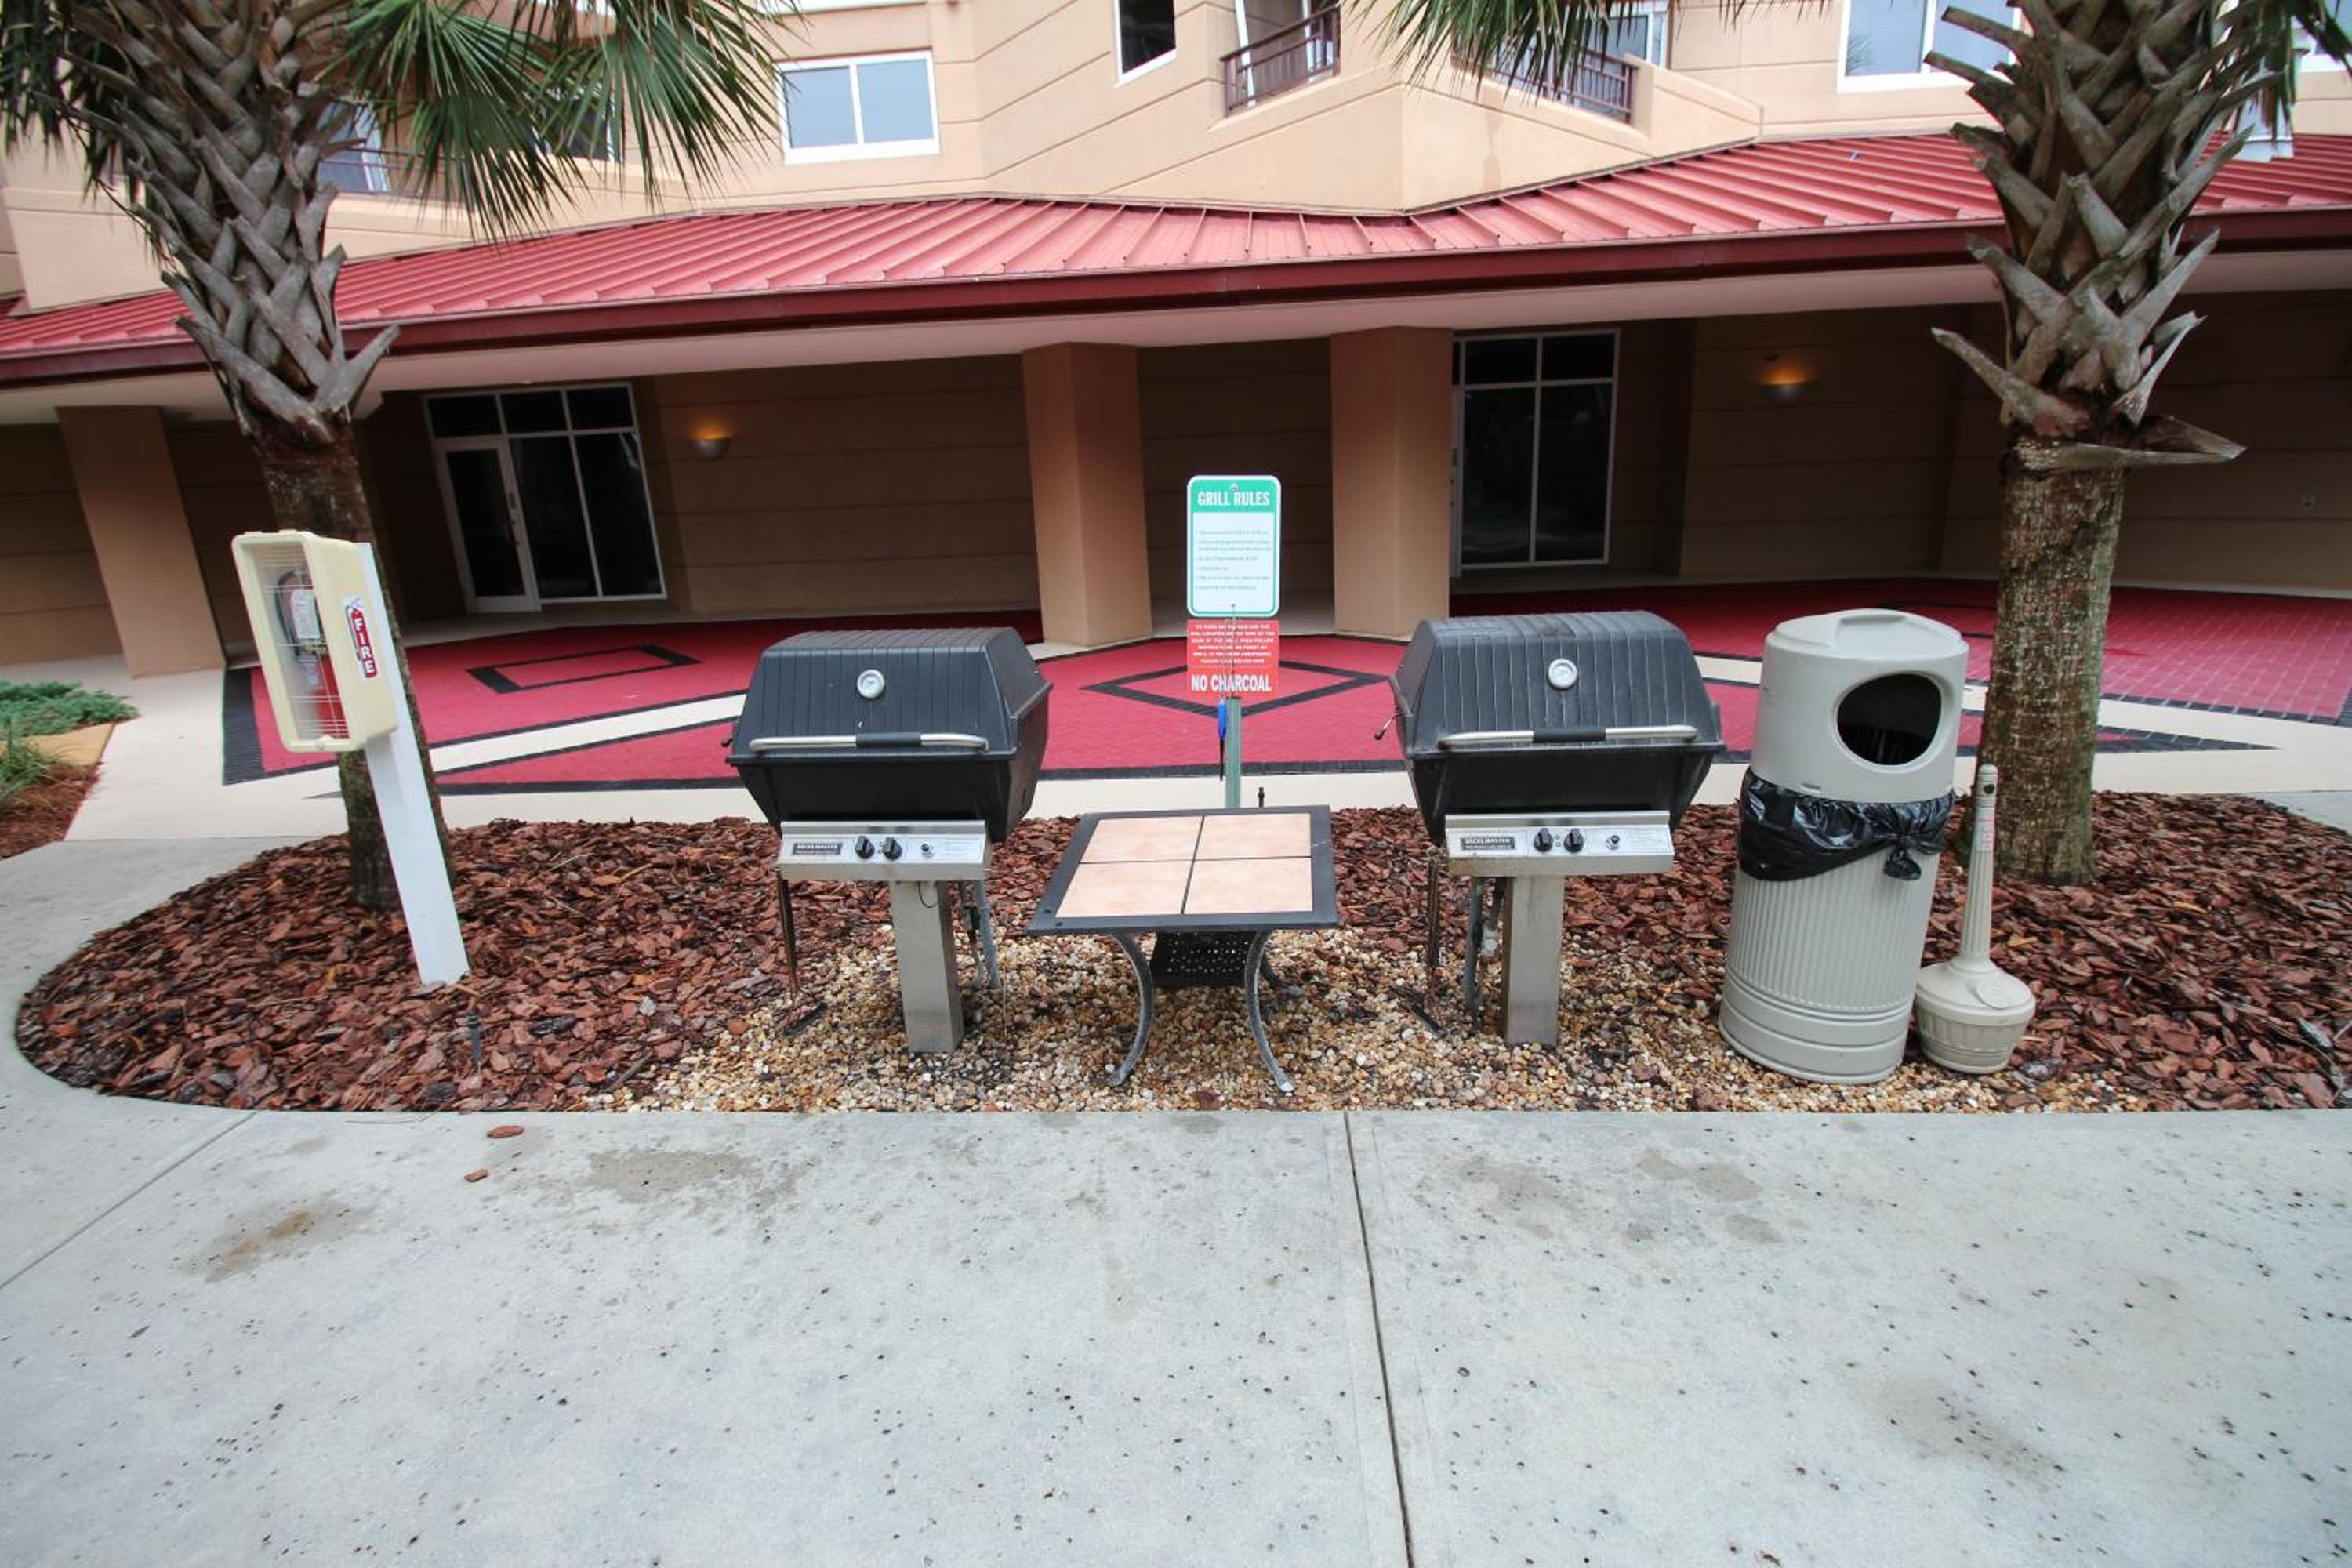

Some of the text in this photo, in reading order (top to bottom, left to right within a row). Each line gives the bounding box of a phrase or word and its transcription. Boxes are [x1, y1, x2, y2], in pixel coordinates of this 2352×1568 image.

[1198, 491, 1270, 506] GRILL RULES
[354, 617, 376, 673] FIRE
[1191, 674, 1272, 692] NO CHARCOAL
